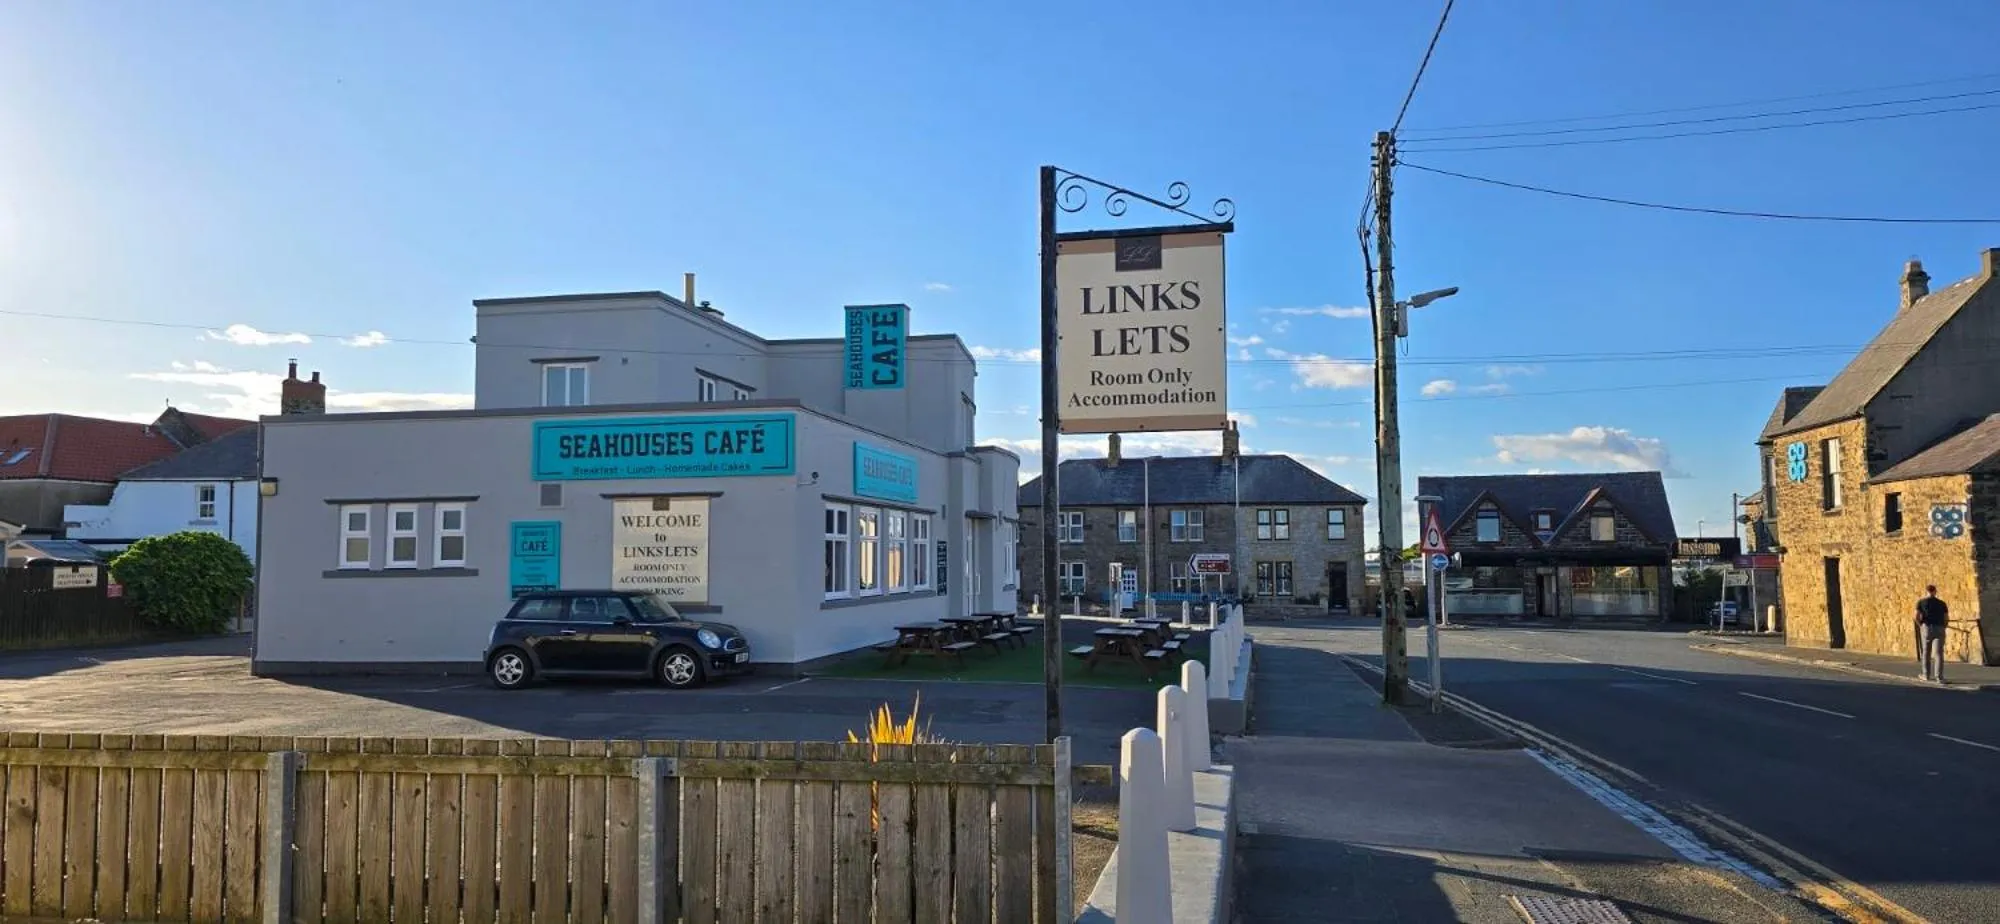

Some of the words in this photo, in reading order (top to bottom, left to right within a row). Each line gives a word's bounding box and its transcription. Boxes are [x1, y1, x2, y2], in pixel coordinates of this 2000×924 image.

[1080, 281, 1201, 315] LINKS
[850, 310, 863, 388] SEAHOUSES
[866, 311, 898, 385] CAFÉ
[1091, 325, 1190, 356] LETS
[1090, 370, 1143, 386] Room
[1148, 367, 1193, 386] Only
[1068, 388, 1217, 408] Accommodation
[559, 431, 693, 459] SEAHOUSES
[704, 423, 765, 454] CAFÉ
[573, 465, 618, 475] Breakfast
[627, 464, 656, 474] Lunch
[664, 462, 717, 473] Homemade
[721, 461, 751, 471] Cakes
[621, 515, 701, 527] WELCOME
[654, 533, 666, 543] to
[623, 547, 663, 557] LINKS
[665, 546, 698, 557] LETS
